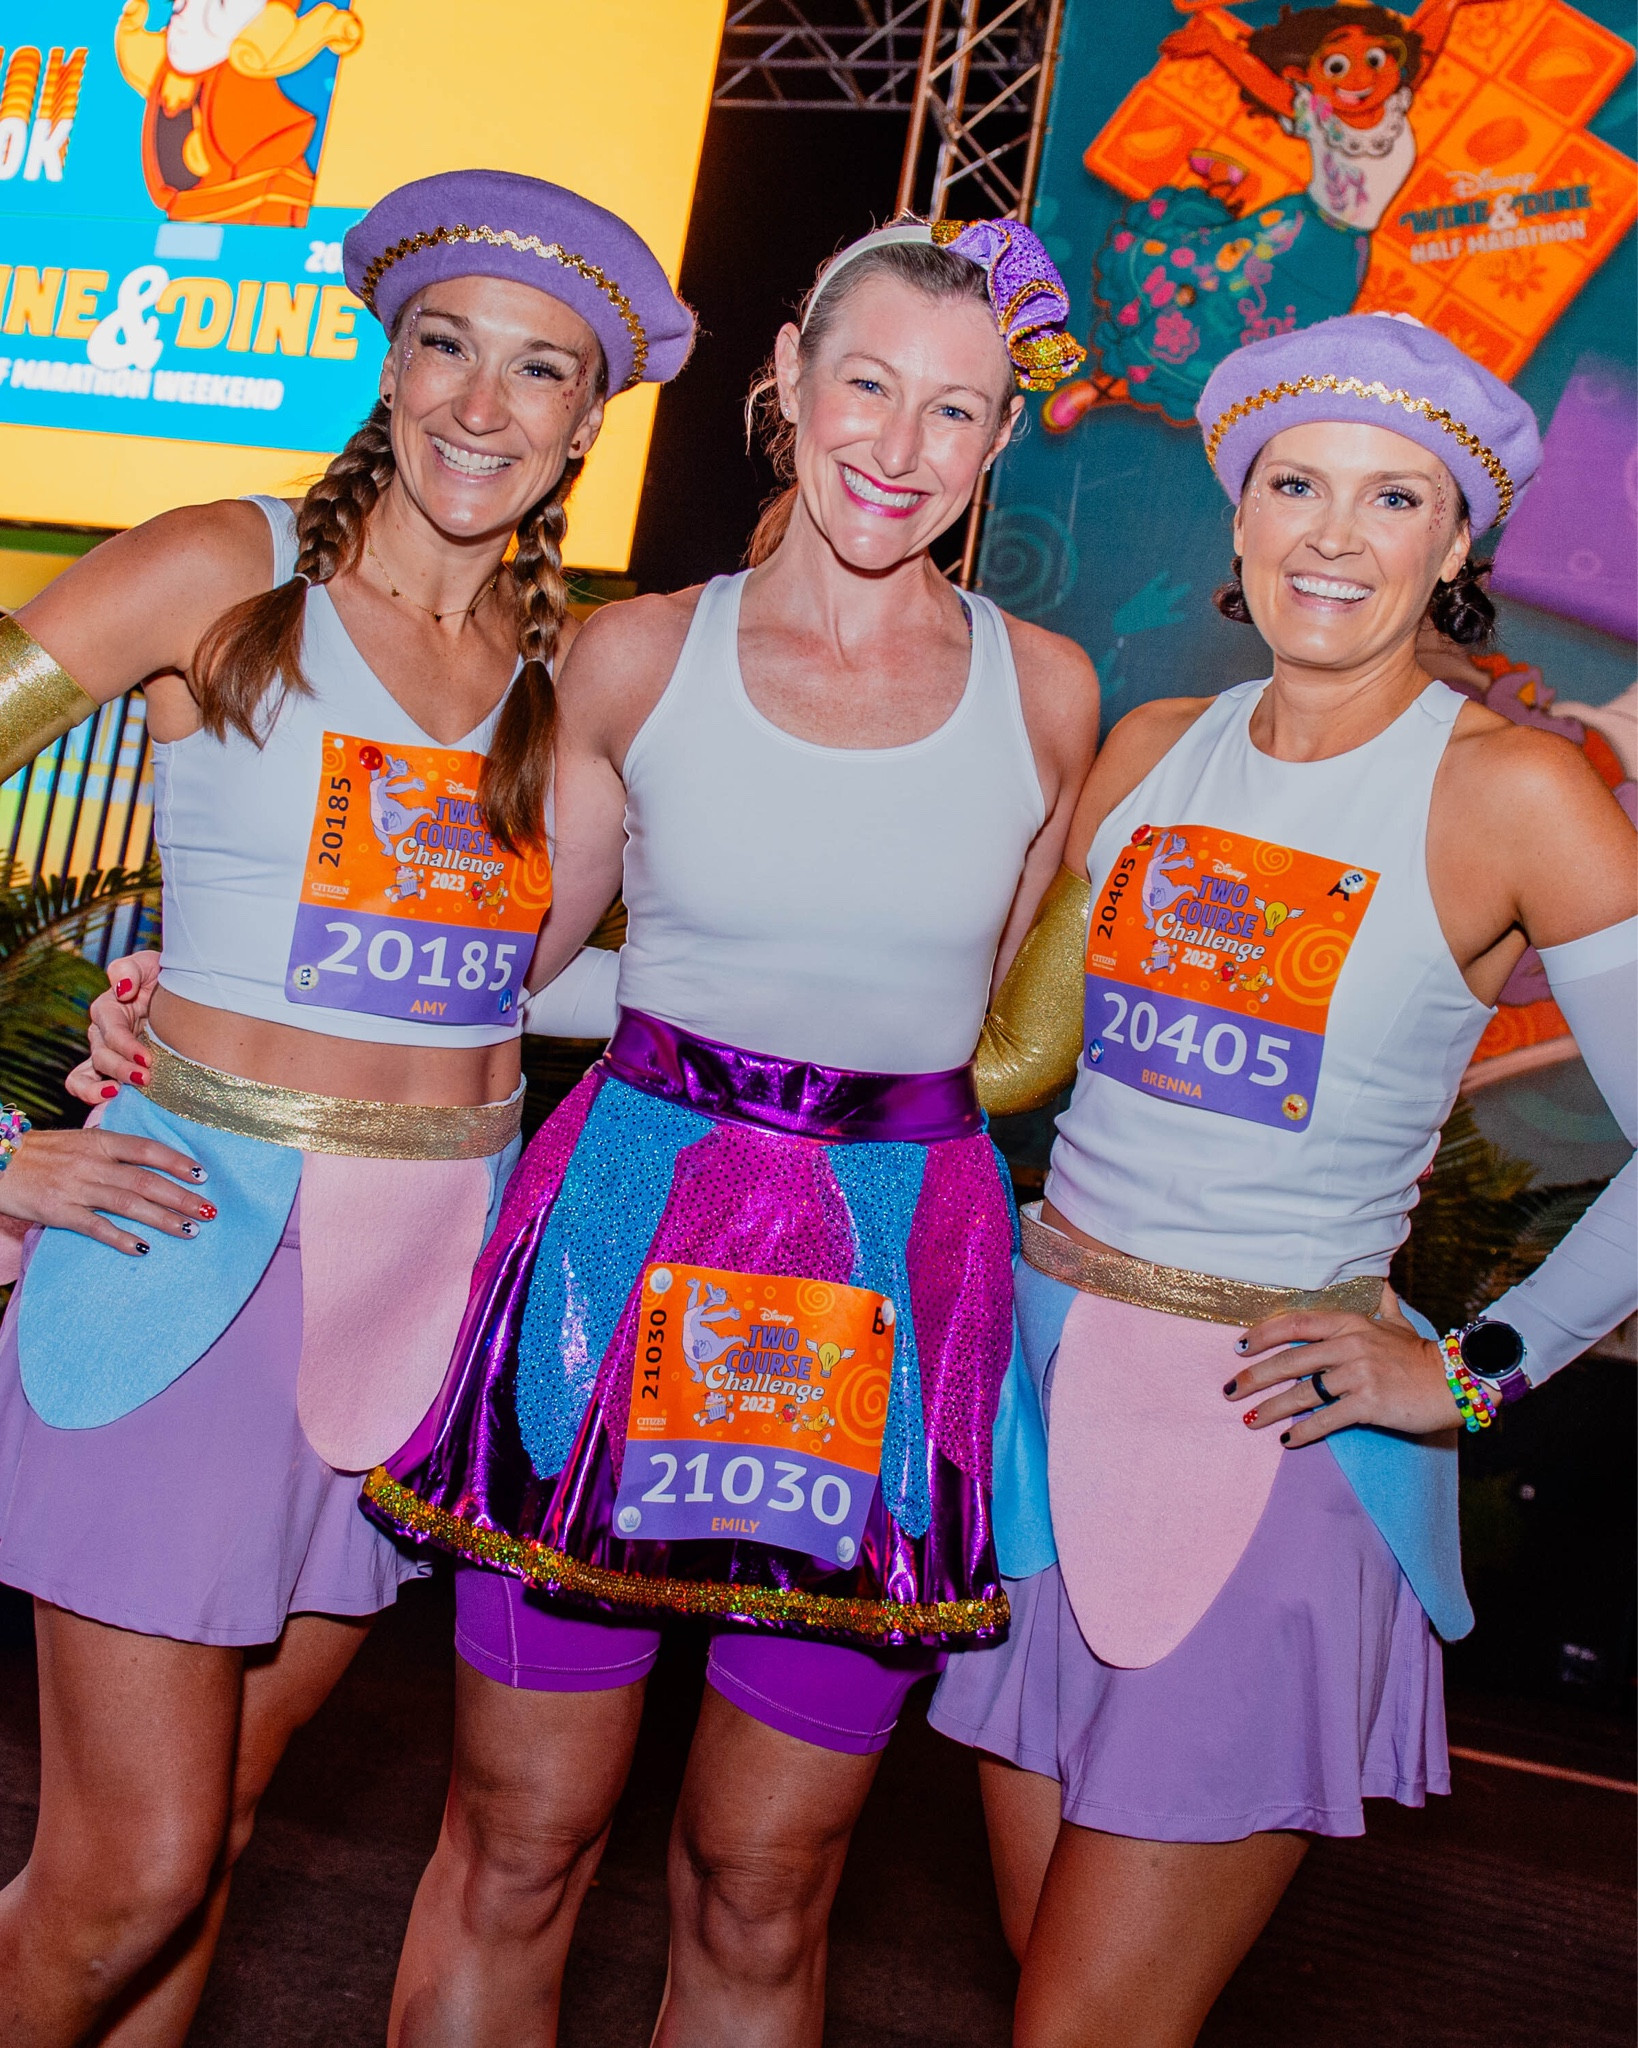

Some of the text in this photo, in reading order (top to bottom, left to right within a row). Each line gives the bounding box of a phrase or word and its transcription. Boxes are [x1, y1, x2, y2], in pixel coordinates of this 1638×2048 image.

[1444, 168, 1538, 198] Disney
[1400, 184, 1593, 234] WINE & DINE
[1410, 220, 1586, 264] HALF MARATHON
[87, 265, 172, 372] &
[156, 276, 365, 360] DINE
[153, 369, 285, 411] WEEKEND
[318, 777, 352, 868] 20185
[436, 796, 483, 828] TWO
[415, 822, 494, 857] COURSE
[395, 837, 505, 881] Challenge
[1212, 859, 1248, 882] Disney
[311, 882, 350, 896] CITIZEN
[430, 871, 466, 892] 2023
[1097, 857, 1136, 940] 20405
[1199, 875, 1249, 907] TWO
[1175, 899, 1258, 939] COURSE
[1155, 912, 1266, 963] Challenge
[317, 921, 517, 992] 20185
[1181, 947, 1217, 970] 2023
[410, 1000, 447, 1016] AMY
[1101, 992, 1293, 1087] 20405
[1141, 1068, 1203, 1099] BRENNA
[758, 1307, 794, 1326] Disney
[641, 1308, 667, 1400] 21030
[749, 1324, 800, 1351] TWO
[725, 1350, 813, 1380] COURSE
[705, 1364, 825, 1404] Challenge
[739, 1395, 776, 1414] 2023
[641, 1453, 852, 1525] 21030
[711, 1517, 761, 1533] EMILY
